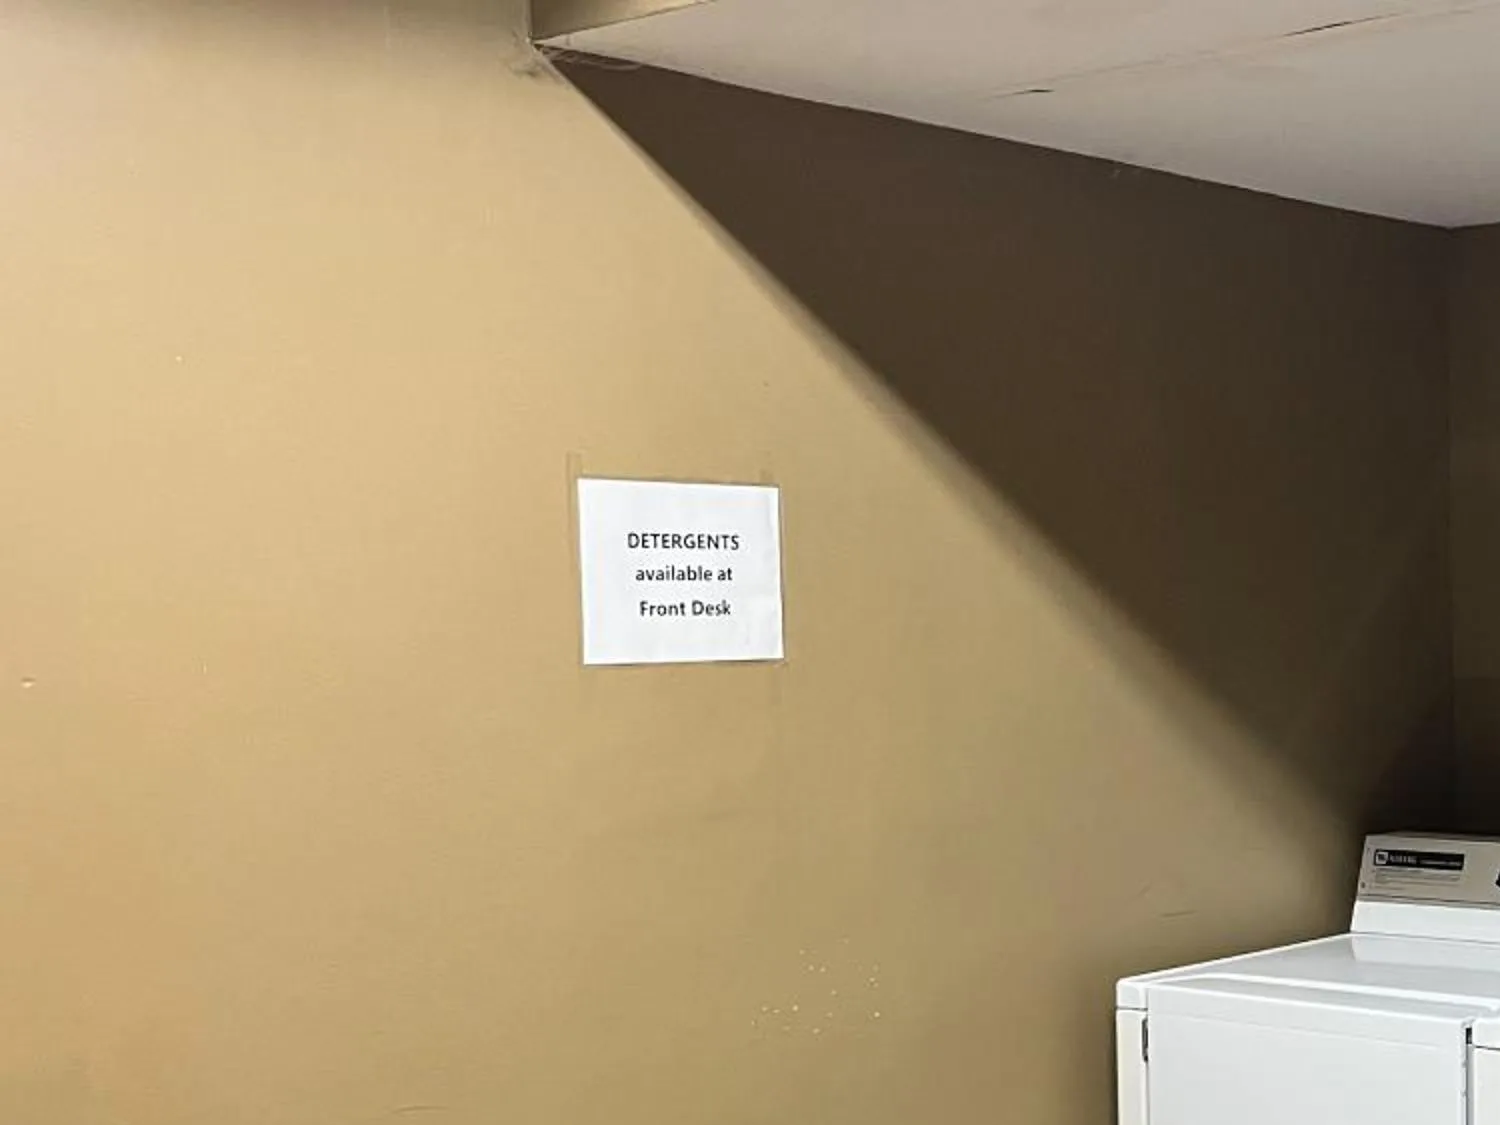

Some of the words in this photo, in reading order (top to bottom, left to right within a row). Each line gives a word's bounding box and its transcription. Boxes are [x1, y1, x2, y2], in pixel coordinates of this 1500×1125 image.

[627, 532, 740, 550] DETERGENTS
[635, 565, 713, 581] available
[717, 567, 733, 581] at
[639, 600, 686, 616] Front
[691, 599, 732, 616] Desk
